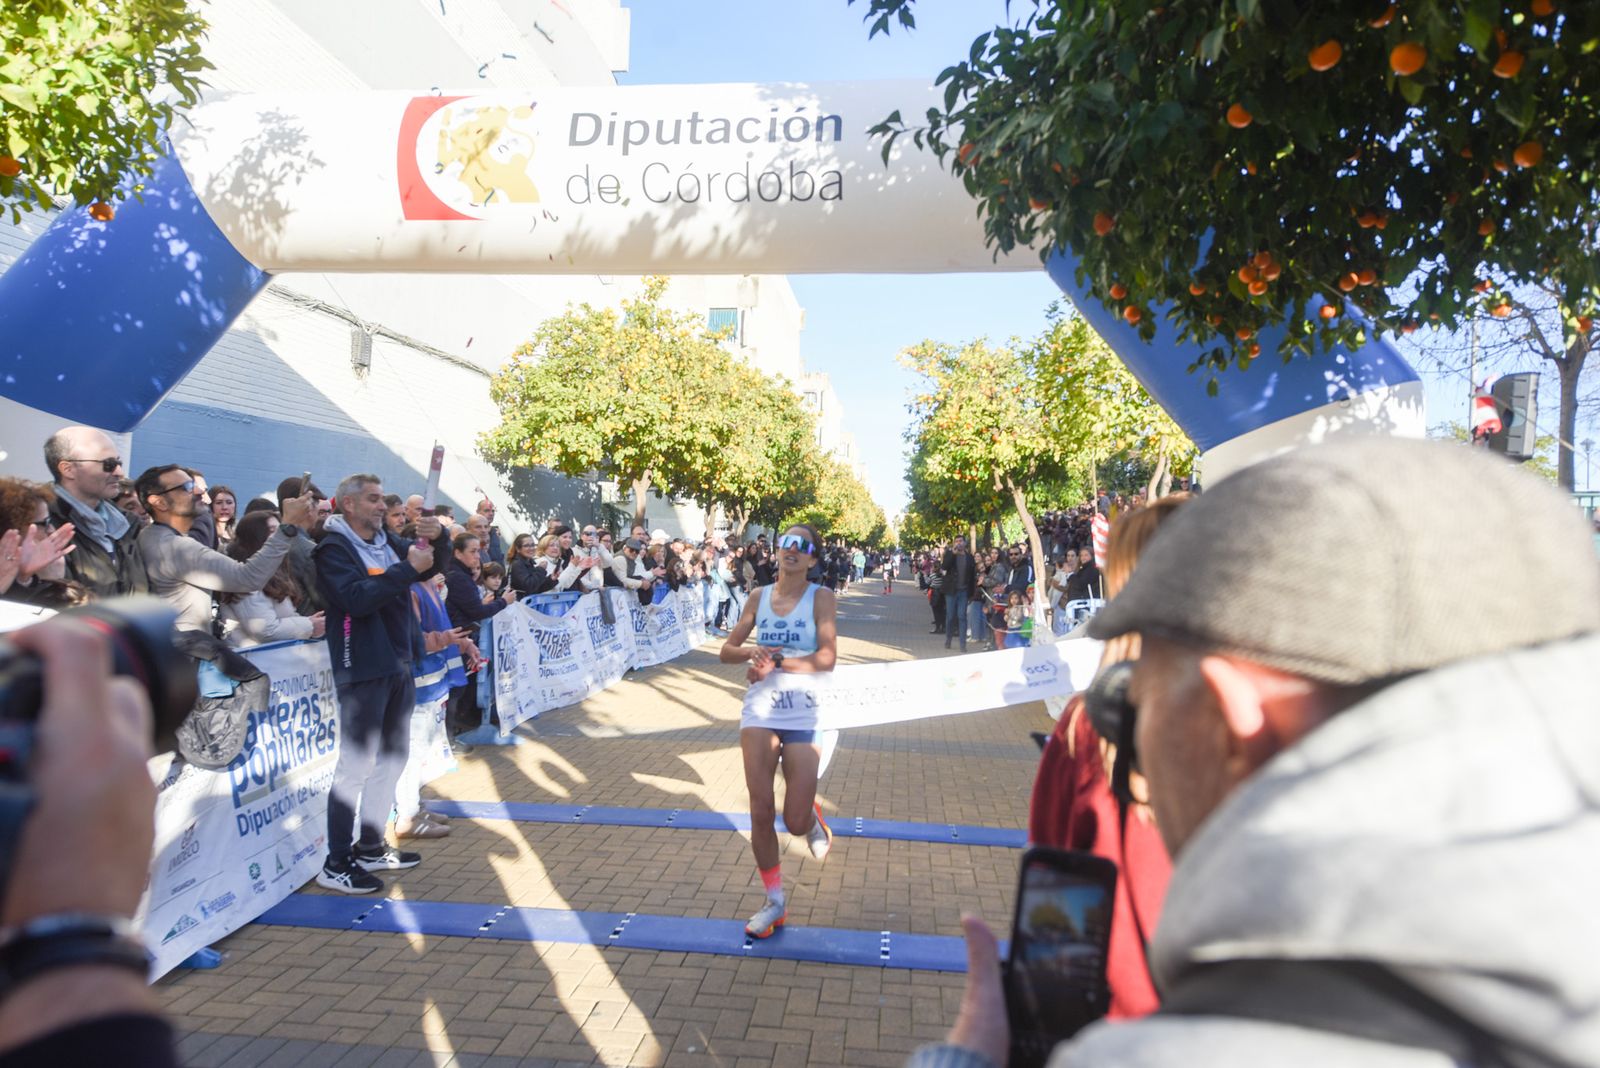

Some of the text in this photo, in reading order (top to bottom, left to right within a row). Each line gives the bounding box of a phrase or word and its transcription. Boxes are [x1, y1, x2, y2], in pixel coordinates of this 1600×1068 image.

[568, 106, 843, 156] Diputación
[566, 161, 843, 204] de Córdoba
[760, 630, 800, 644] nerja
[271, 671, 318, 699] PROVINCIAL
[318, 669, 333, 694] 20
[243, 693, 322, 751] arreras
[320, 693, 335, 719] 25
[226, 718, 336, 808] populares
